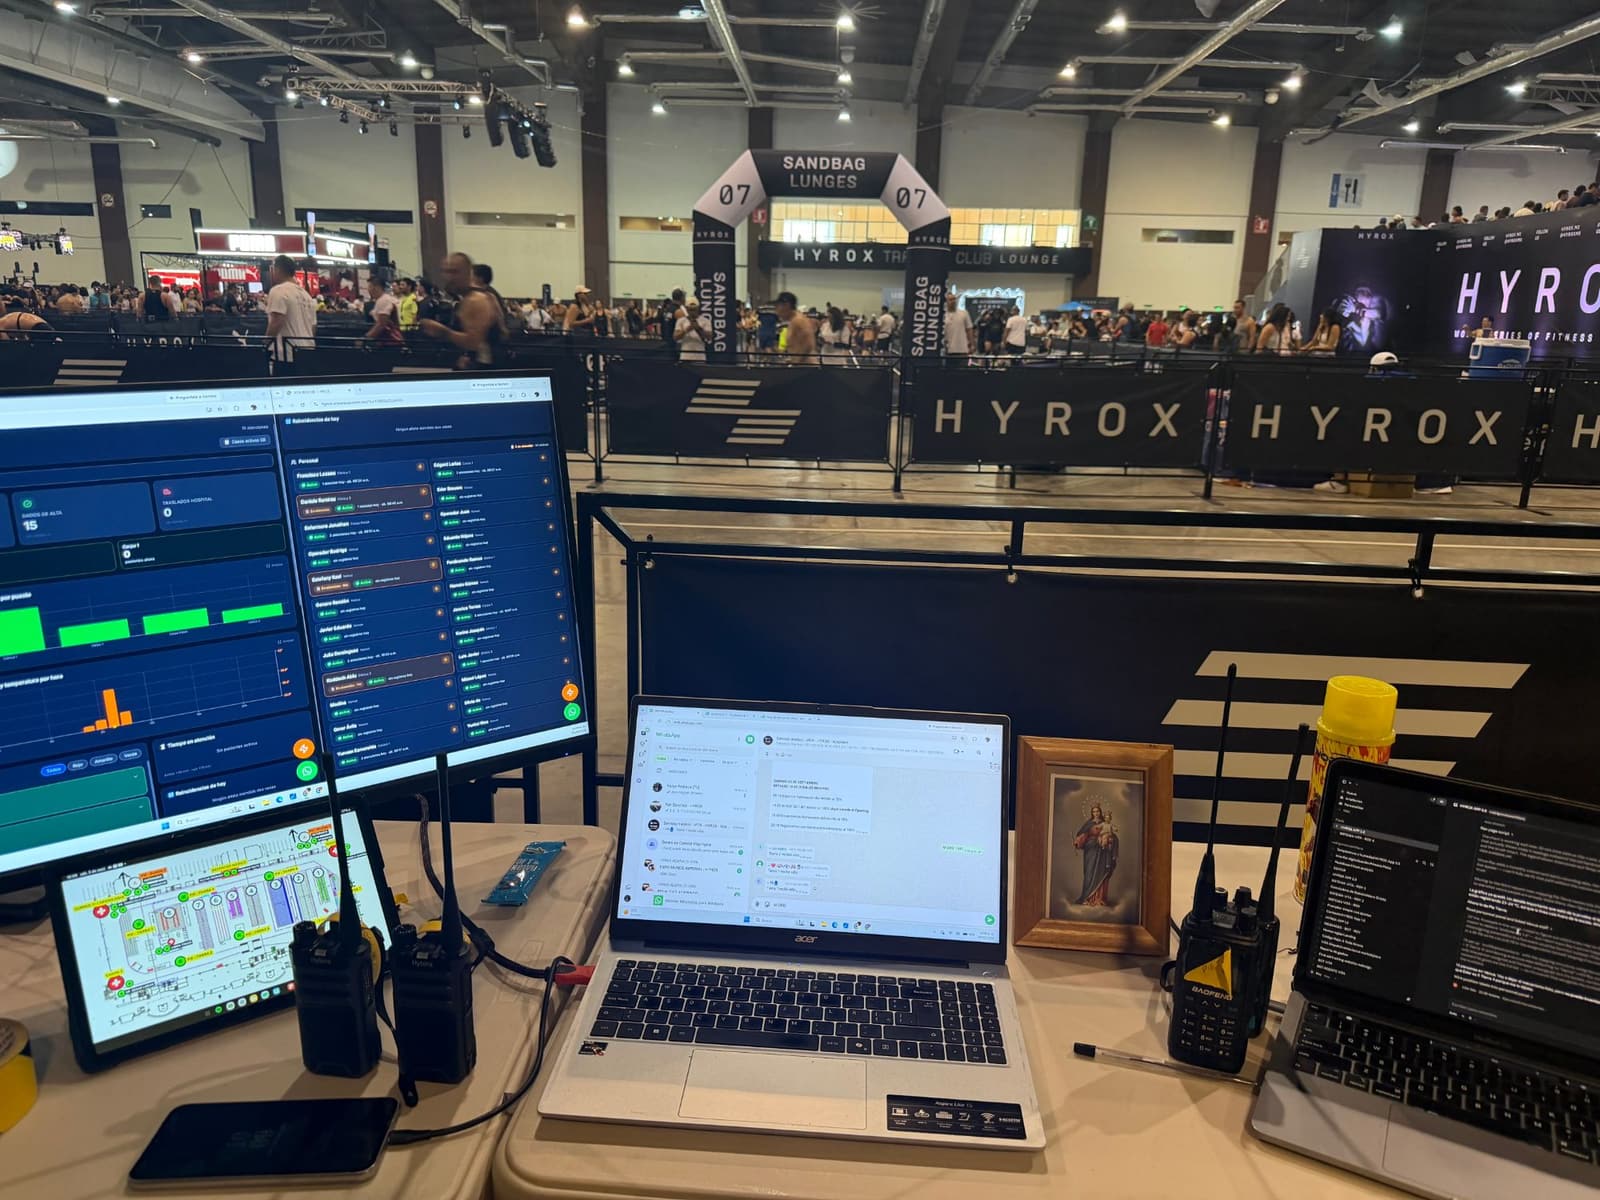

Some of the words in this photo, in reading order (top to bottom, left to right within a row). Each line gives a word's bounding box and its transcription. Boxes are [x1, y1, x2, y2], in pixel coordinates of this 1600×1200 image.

[783, 156, 866, 171] SANDBAG
[790, 174, 857, 189] LUNGES
[719, 184, 751, 205] 07
[896, 187, 926, 209] 07
[794, 249, 874, 263] HYROX
[956, 252, 992, 265] CLUB
[1000, 254, 1059, 265] LOUNGE
[700, 279, 712, 324] LUNG
[713, 272, 727, 352] SANDBAG
[912, 276, 929, 357] SANDBAG
[926, 284, 941, 351] LUNGES
[1528, 332, 1540, 340] OF
[1545, 332, 1593, 342] FITNESS
[934, 400, 1182, 438] HYROX
[1250, 404, 1502, 446] HYROX
[163, 508, 172, 518] 0
[23, 520, 38, 531] 15
[123, 550, 131, 558] 0
[794, 934, 818, 943] acer
